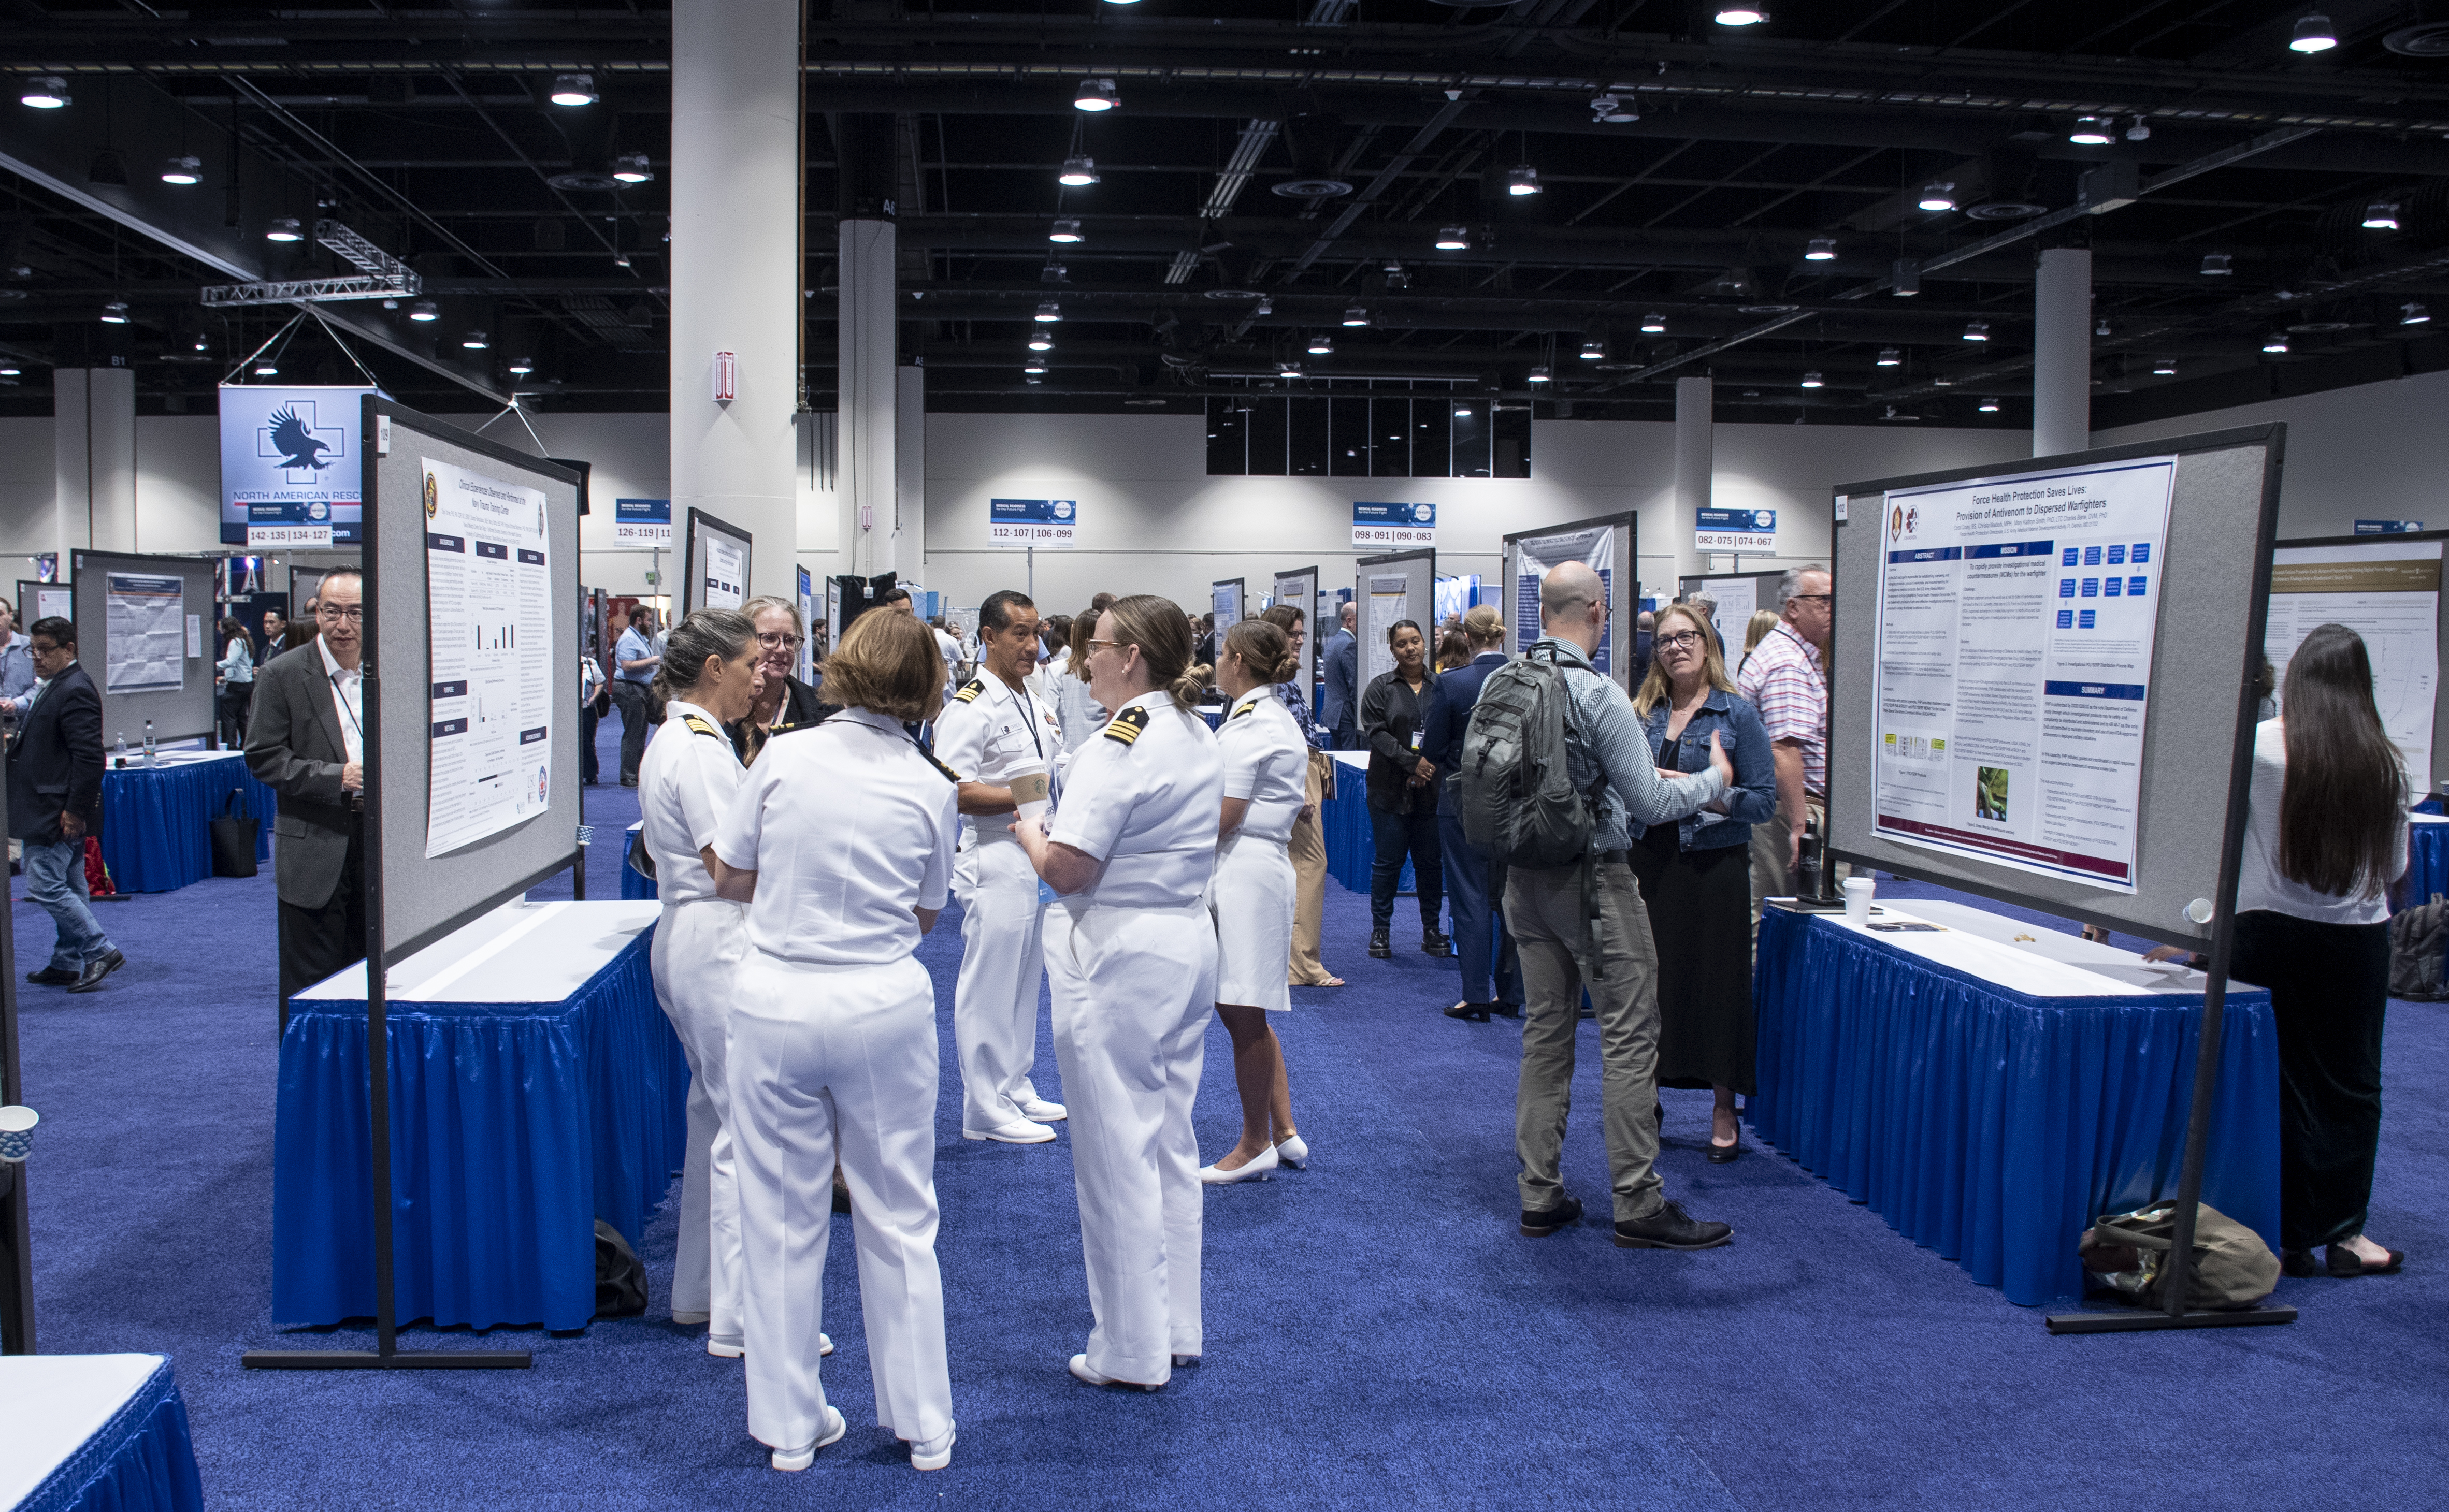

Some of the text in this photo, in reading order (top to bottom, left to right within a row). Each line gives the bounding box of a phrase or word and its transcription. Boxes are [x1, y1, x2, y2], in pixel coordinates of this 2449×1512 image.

[883, 199, 895, 216] A6
[111, 355, 125, 366] B1
[273, 491, 328, 500] AMERICAN
[1972, 485, 2087, 505] Force Health Protection Saves Lives:
[1956, 499, 2106, 521] Provision of Antivenom to Dispersed Warfighters
[251, 531, 328, 540] 142-135 134-127
[618, 528, 654, 537] 126-119
[993, 528, 1072, 538] 112-107 106-099
[1355, 530, 1432, 541] 098-091 090-083
[1698, 536, 1772, 546] 082-075 074-067
[1914, 551, 1934, 560] ABSTRACT
[2000, 546, 2018, 555] MISSION
[1988, 562, 2002, 571] provide
[2003, 561, 2030, 569] investigational
[2026, 570, 2047, 578] warfighter
[2081, 686, 2105, 694] SUMMARY
